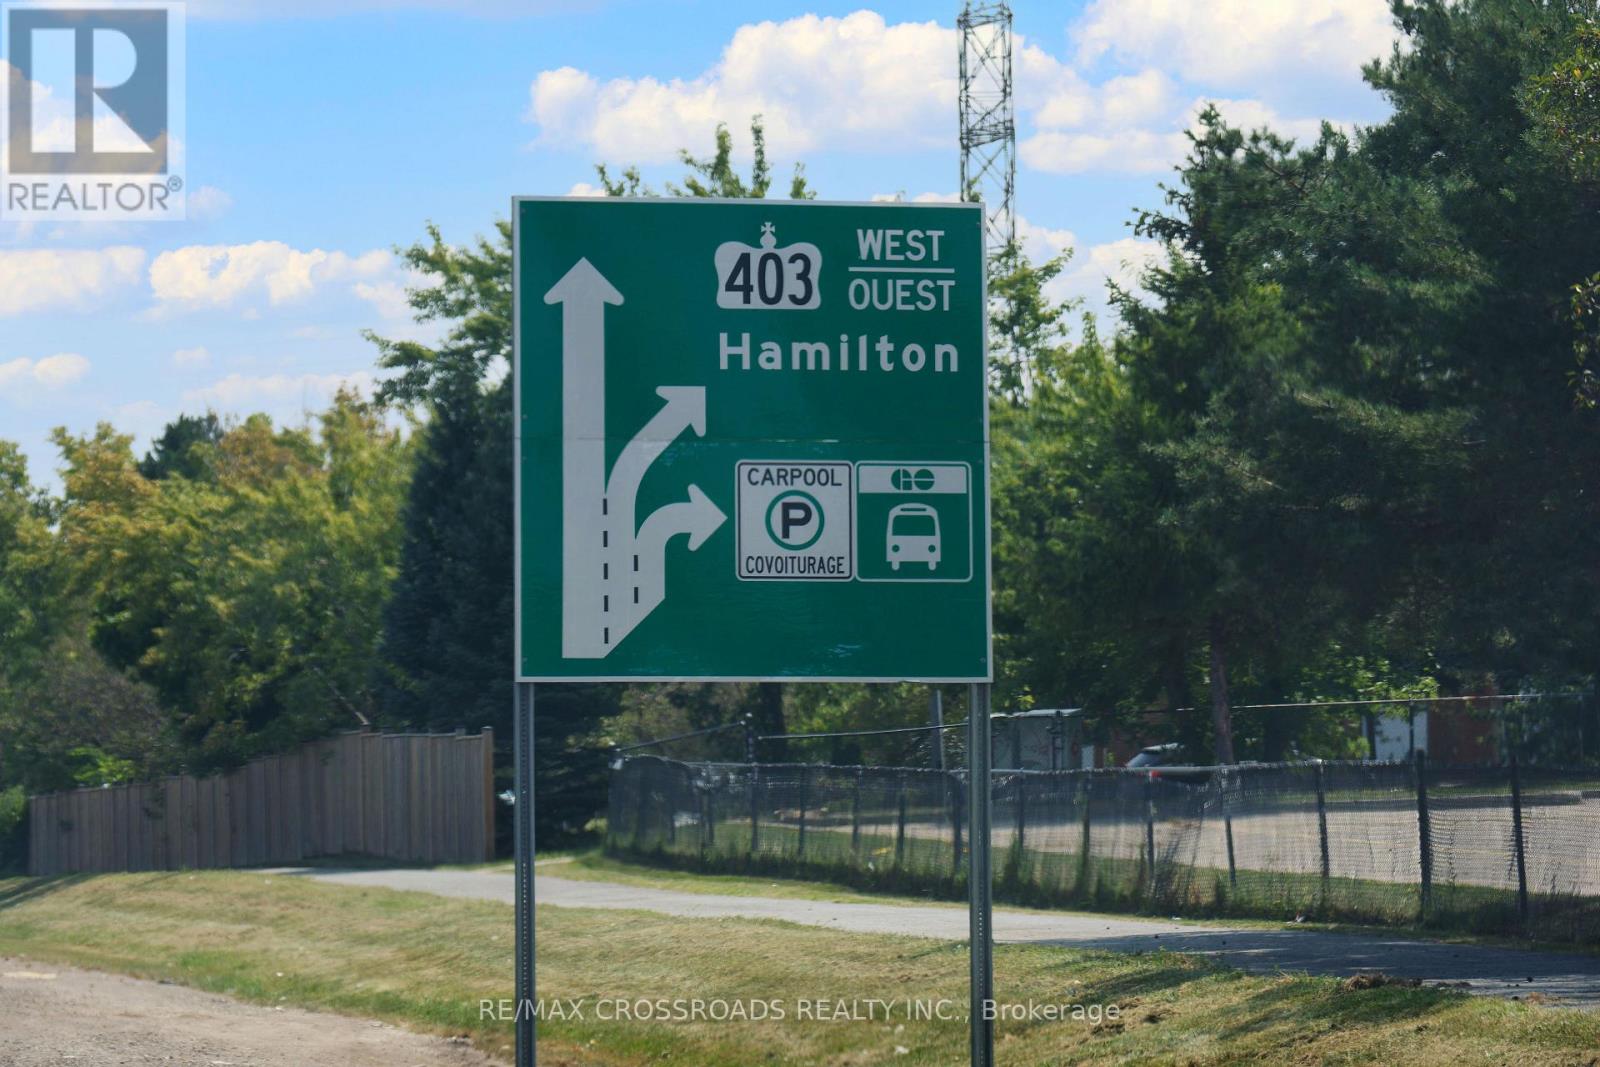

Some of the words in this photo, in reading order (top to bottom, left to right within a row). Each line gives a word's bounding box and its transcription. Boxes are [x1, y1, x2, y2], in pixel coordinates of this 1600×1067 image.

[856, 228, 945, 262] WEST
[724, 251, 814, 306] 403
[848, 278, 956, 312] OUEST
[719, 332, 959, 372] Hamilton
[747, 468, 842, 487] CARPOOL
[781, 501, 813, 540] P
[745, 555, 845, 574] COVOITURAGE
